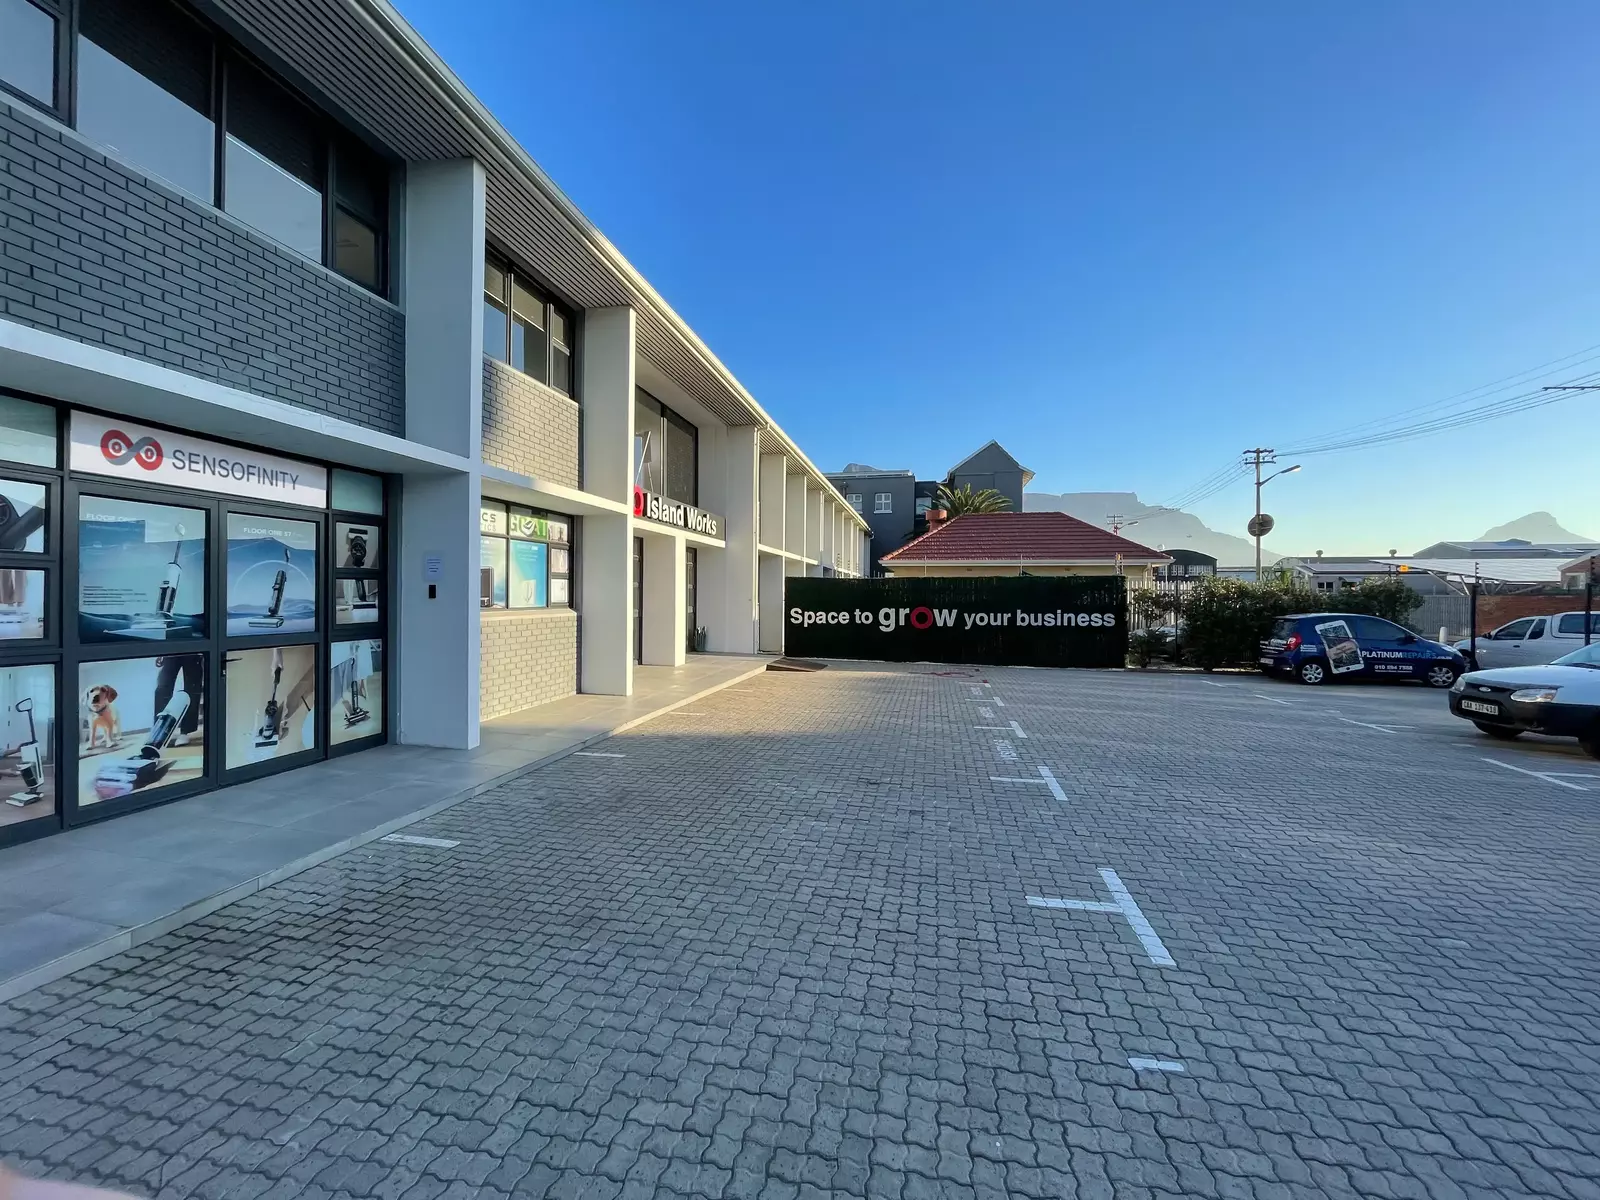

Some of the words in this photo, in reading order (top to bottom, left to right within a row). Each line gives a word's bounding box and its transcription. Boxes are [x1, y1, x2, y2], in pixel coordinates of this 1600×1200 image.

[172, 449, 299, 490] SENSOFINITY
[646, 492, 684, 527] Island
[686, 506, 717, 535] Works
[243, 527, 267, 535] FLOOR
[267, 529, 283, 537] ONE
[790, 607, 850, 627] Space
[854, 608, 873, 624] to
[878, 606, 958, 632] grow
[963, 611, 1011, 630] your
[1016, 609, 1116, 627] business
